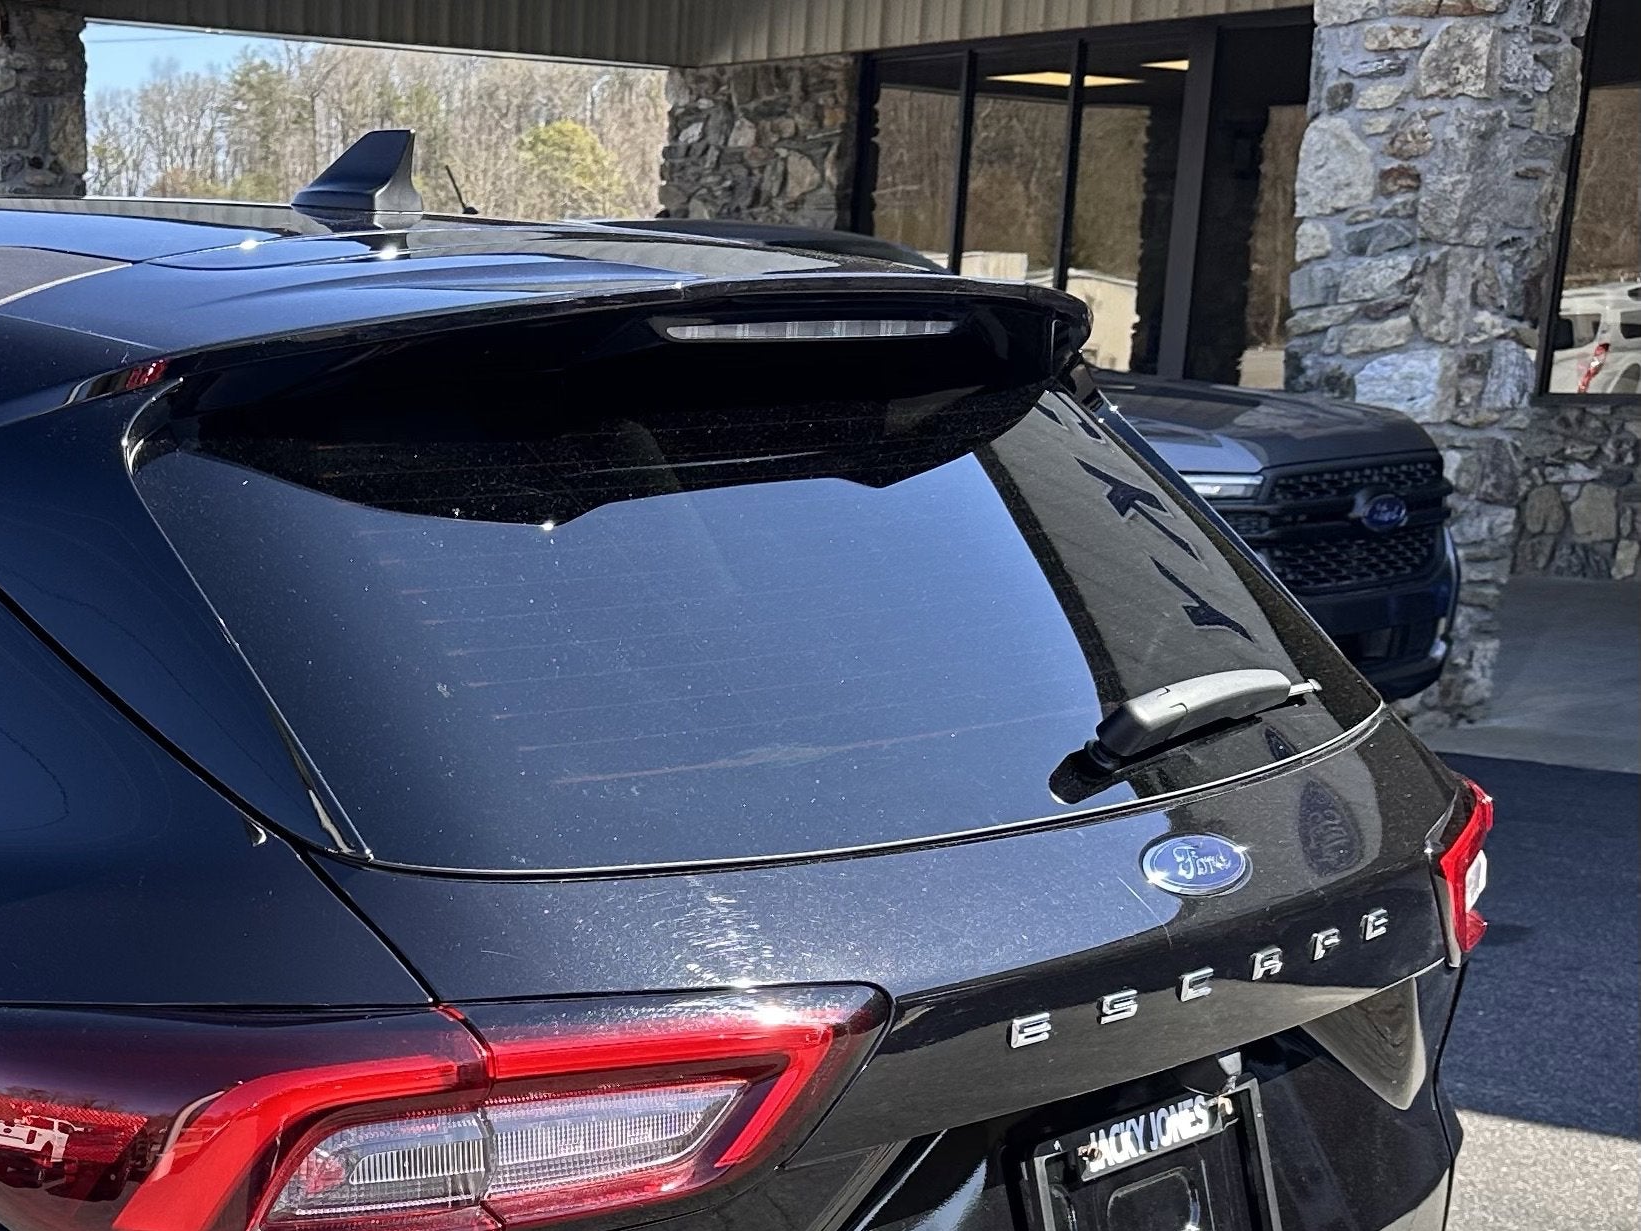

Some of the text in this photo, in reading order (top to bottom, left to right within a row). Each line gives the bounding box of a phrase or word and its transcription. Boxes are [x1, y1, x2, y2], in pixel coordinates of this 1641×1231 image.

[1172, 844, 1232, 880] Ford
[1009, 908, 1389, 1049] ESCAPE
[1086, 1095, 1209, 1173] JACKY JONES
